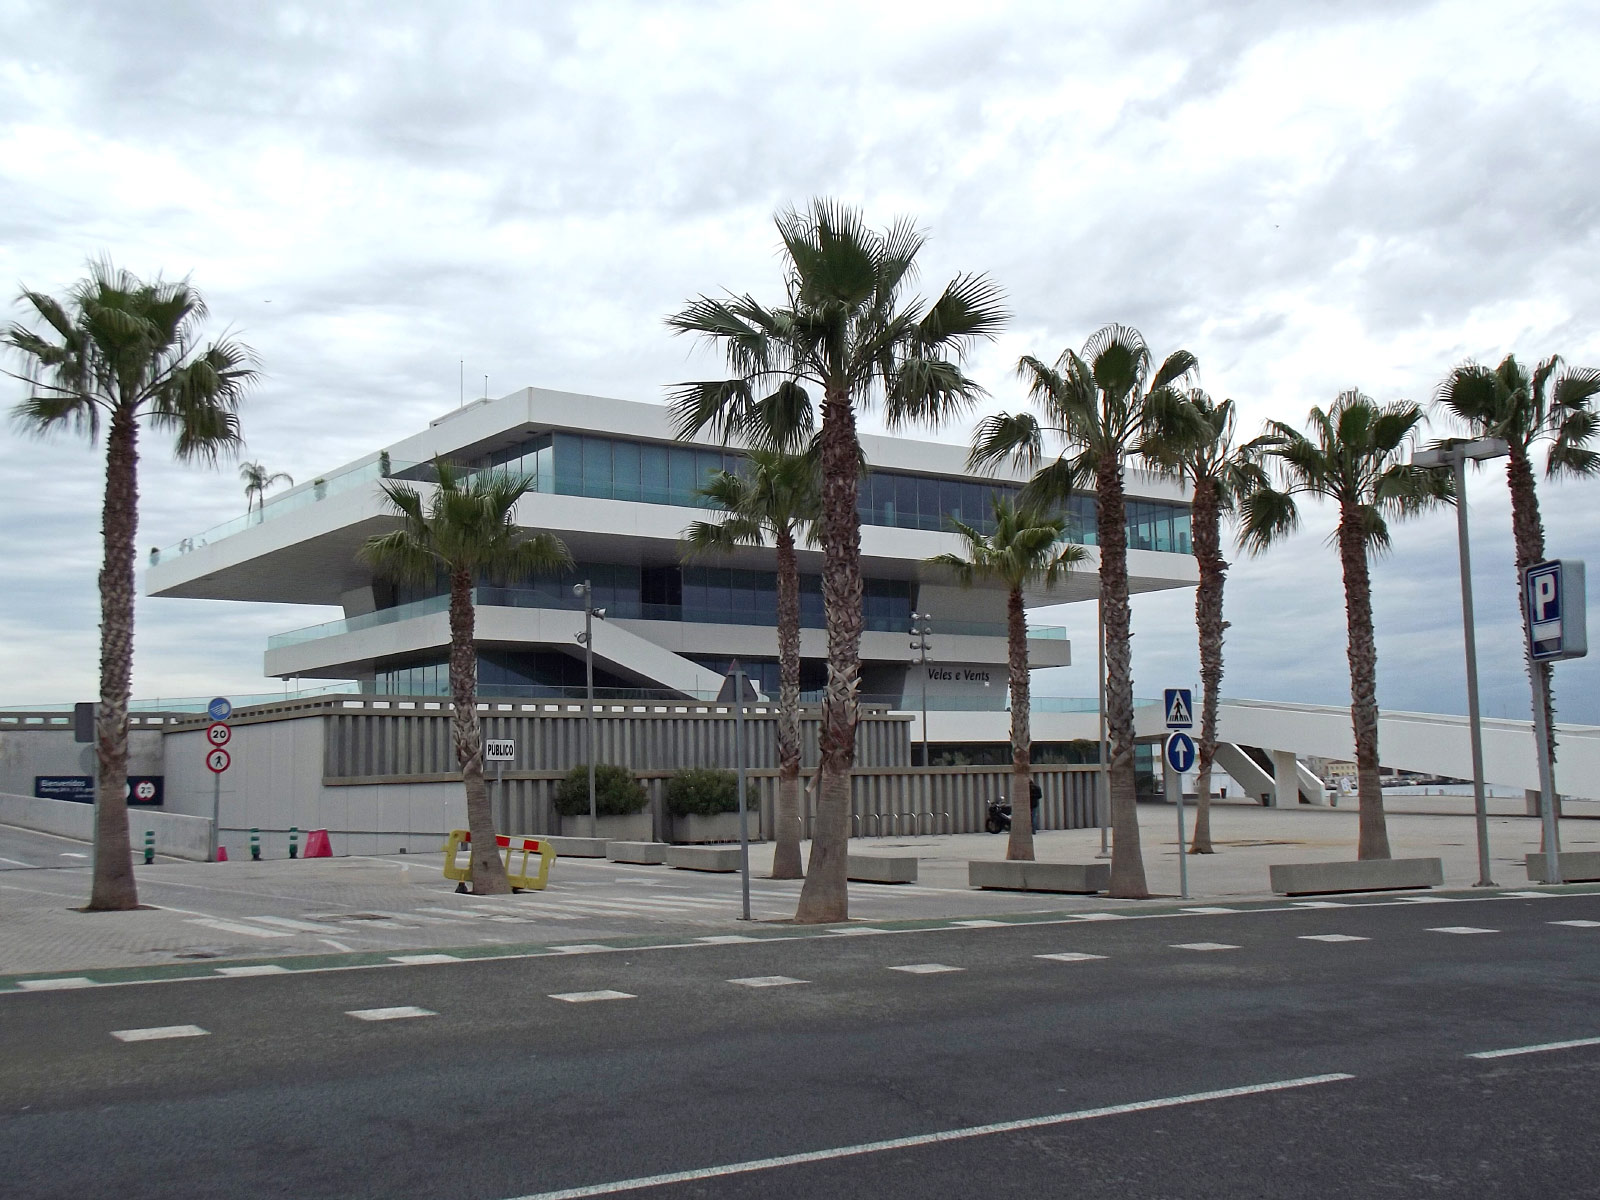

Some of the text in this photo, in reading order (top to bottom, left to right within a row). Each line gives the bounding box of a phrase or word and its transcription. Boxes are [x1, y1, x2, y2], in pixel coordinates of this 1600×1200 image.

[1535, 573, 1556, 621] P
[928, 667, 990, 682] Veles e Vents
[212, 730, 227, 739] 20
[487, 741, 514, 756] PÚBLICO
[41, 779, 86, 787] Bienvenidos
